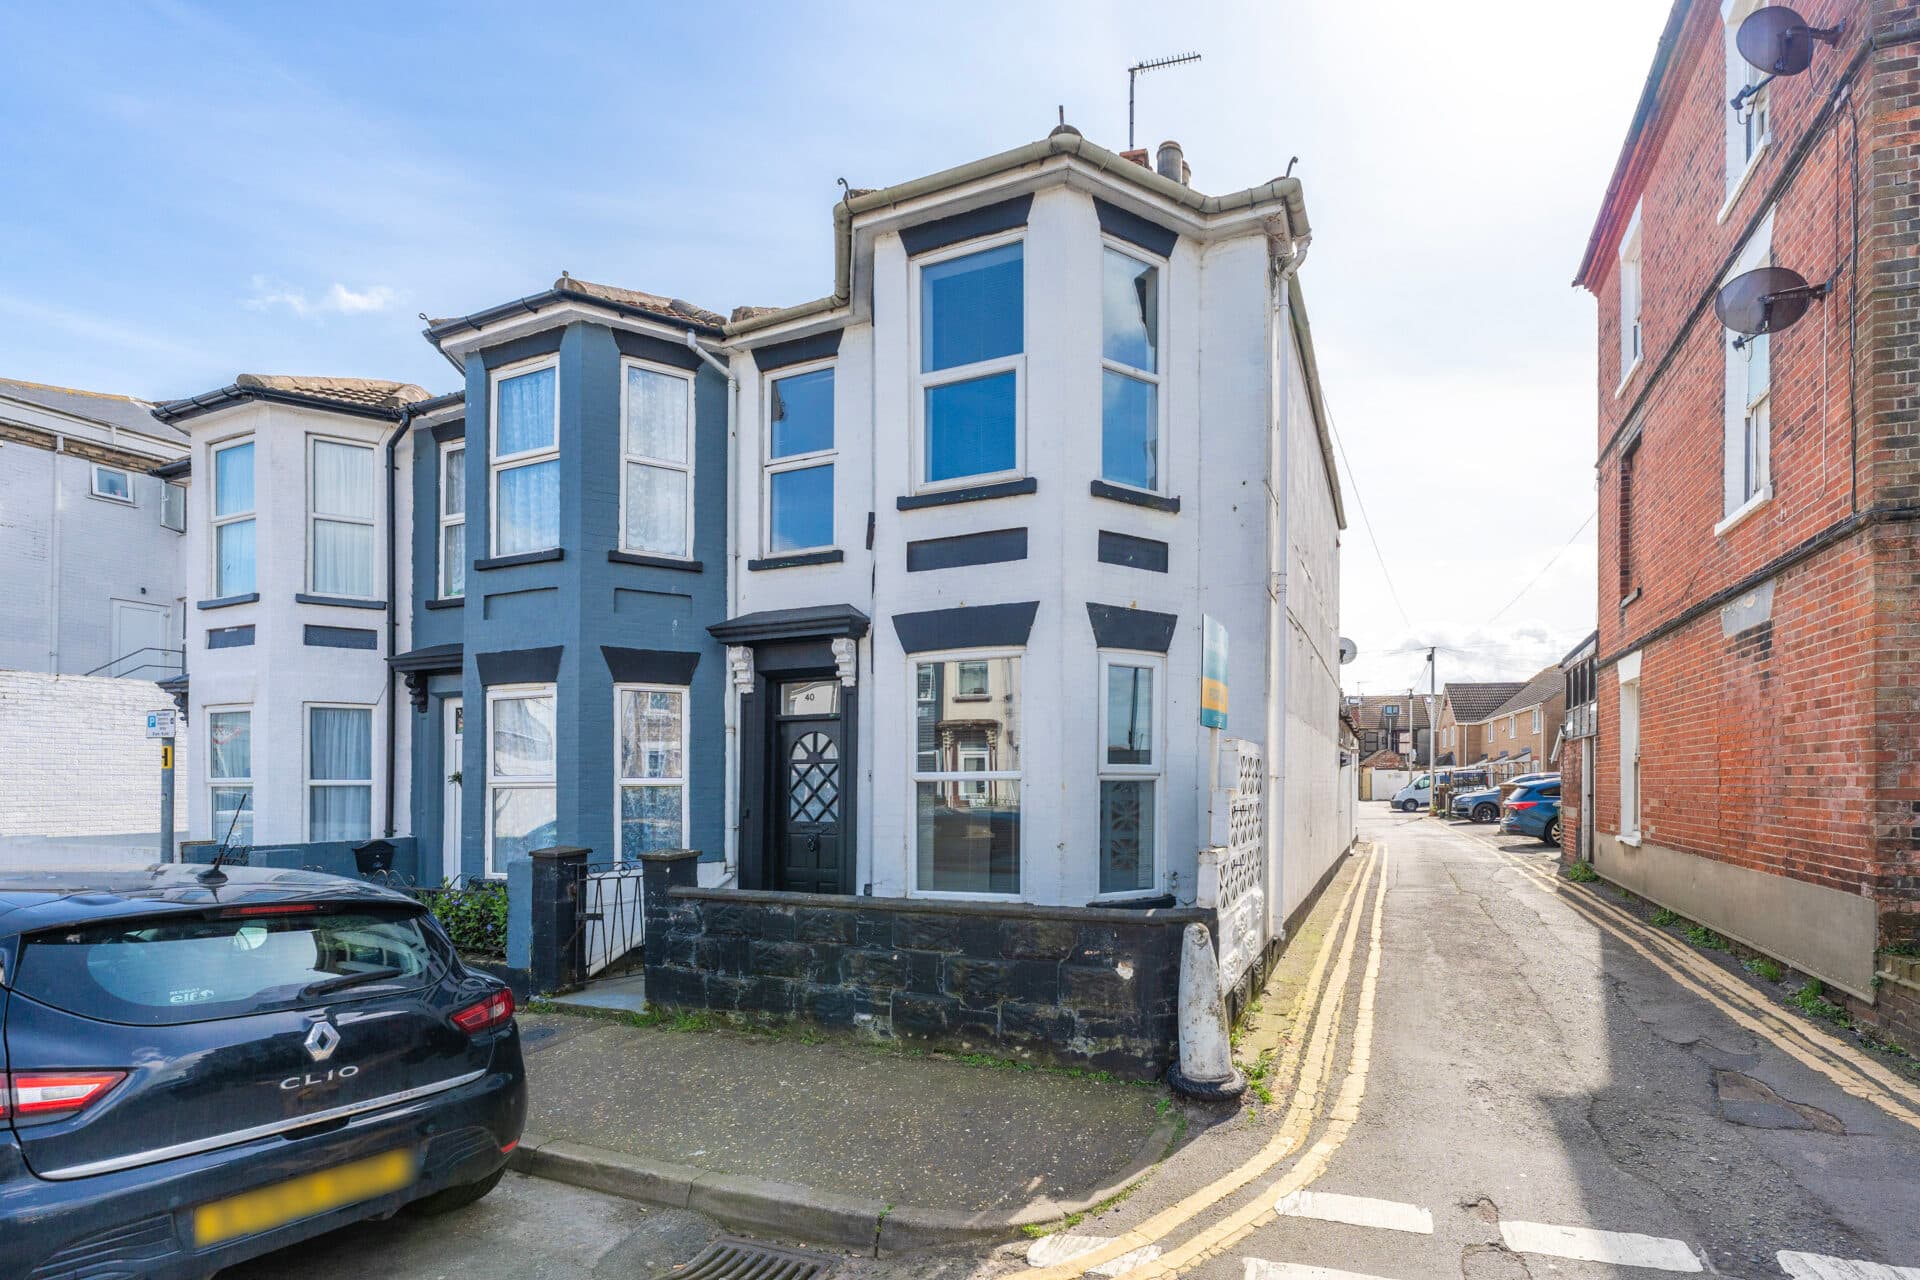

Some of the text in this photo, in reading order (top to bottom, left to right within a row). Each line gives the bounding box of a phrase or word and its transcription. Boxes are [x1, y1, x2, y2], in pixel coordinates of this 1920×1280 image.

[805, 693, 815, 701] 40
[150, 717, 155, 726] P
[170, 992, 199, 1003] elf
[280, 1065, 359, 1090] CLIO
